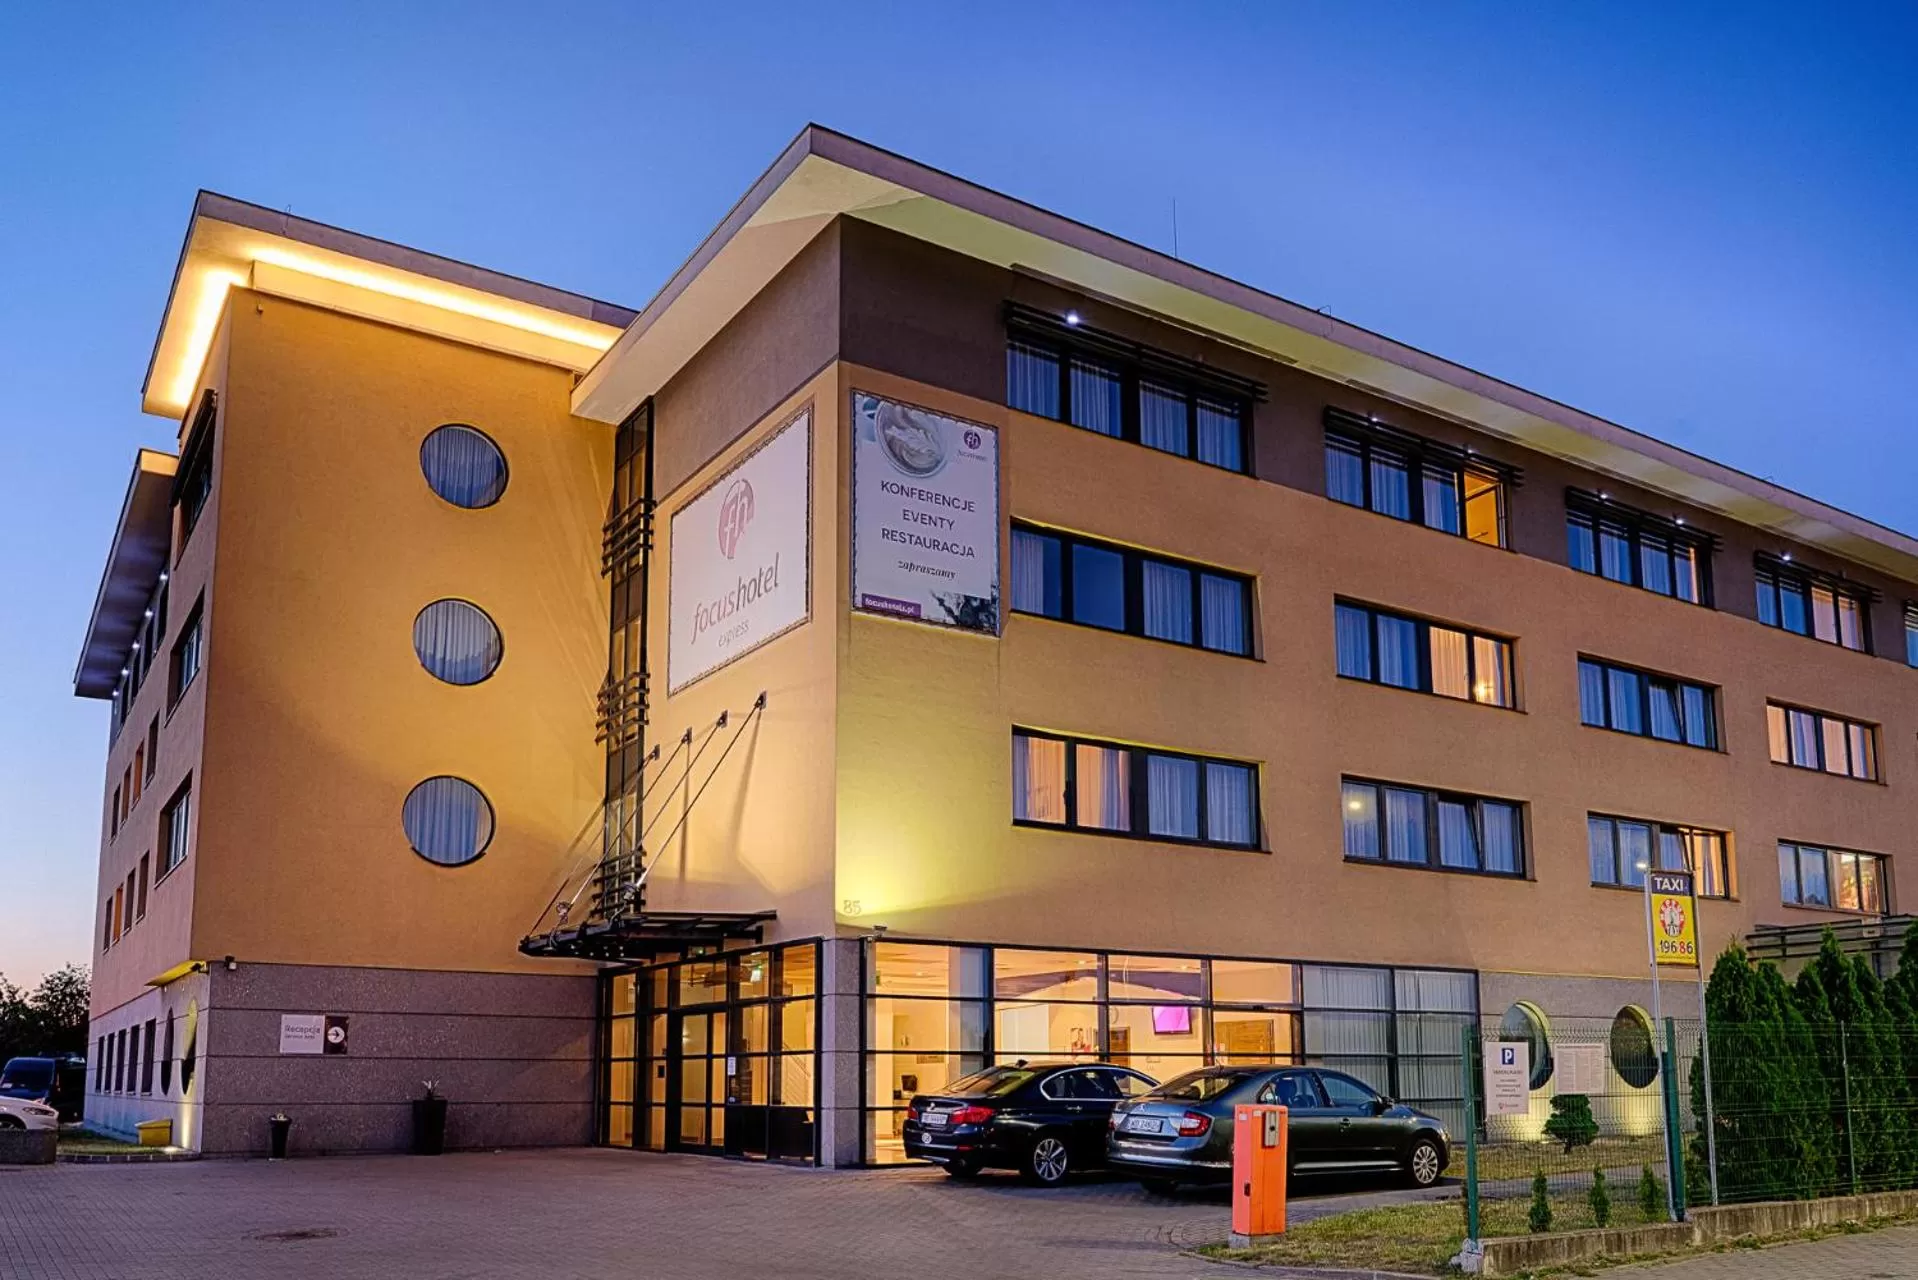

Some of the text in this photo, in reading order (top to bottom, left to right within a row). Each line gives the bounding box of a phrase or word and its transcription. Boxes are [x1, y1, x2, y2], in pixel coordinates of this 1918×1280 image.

[881, 480, 975, 512] KONFERENCJE
[902, 509, 955, 531] EVENTY
[881, 528, 975, 557] RESTAURACJA
[898, 560, 956, 580] zapraszamy
[691, 552, 779, 644] focushotel
[718, 619, 750, 647] express
[1654, 877, 1683, 891] TAXI
[843, 899, 862, 915] 85
[1504, 1049, 1513, 1064] P
